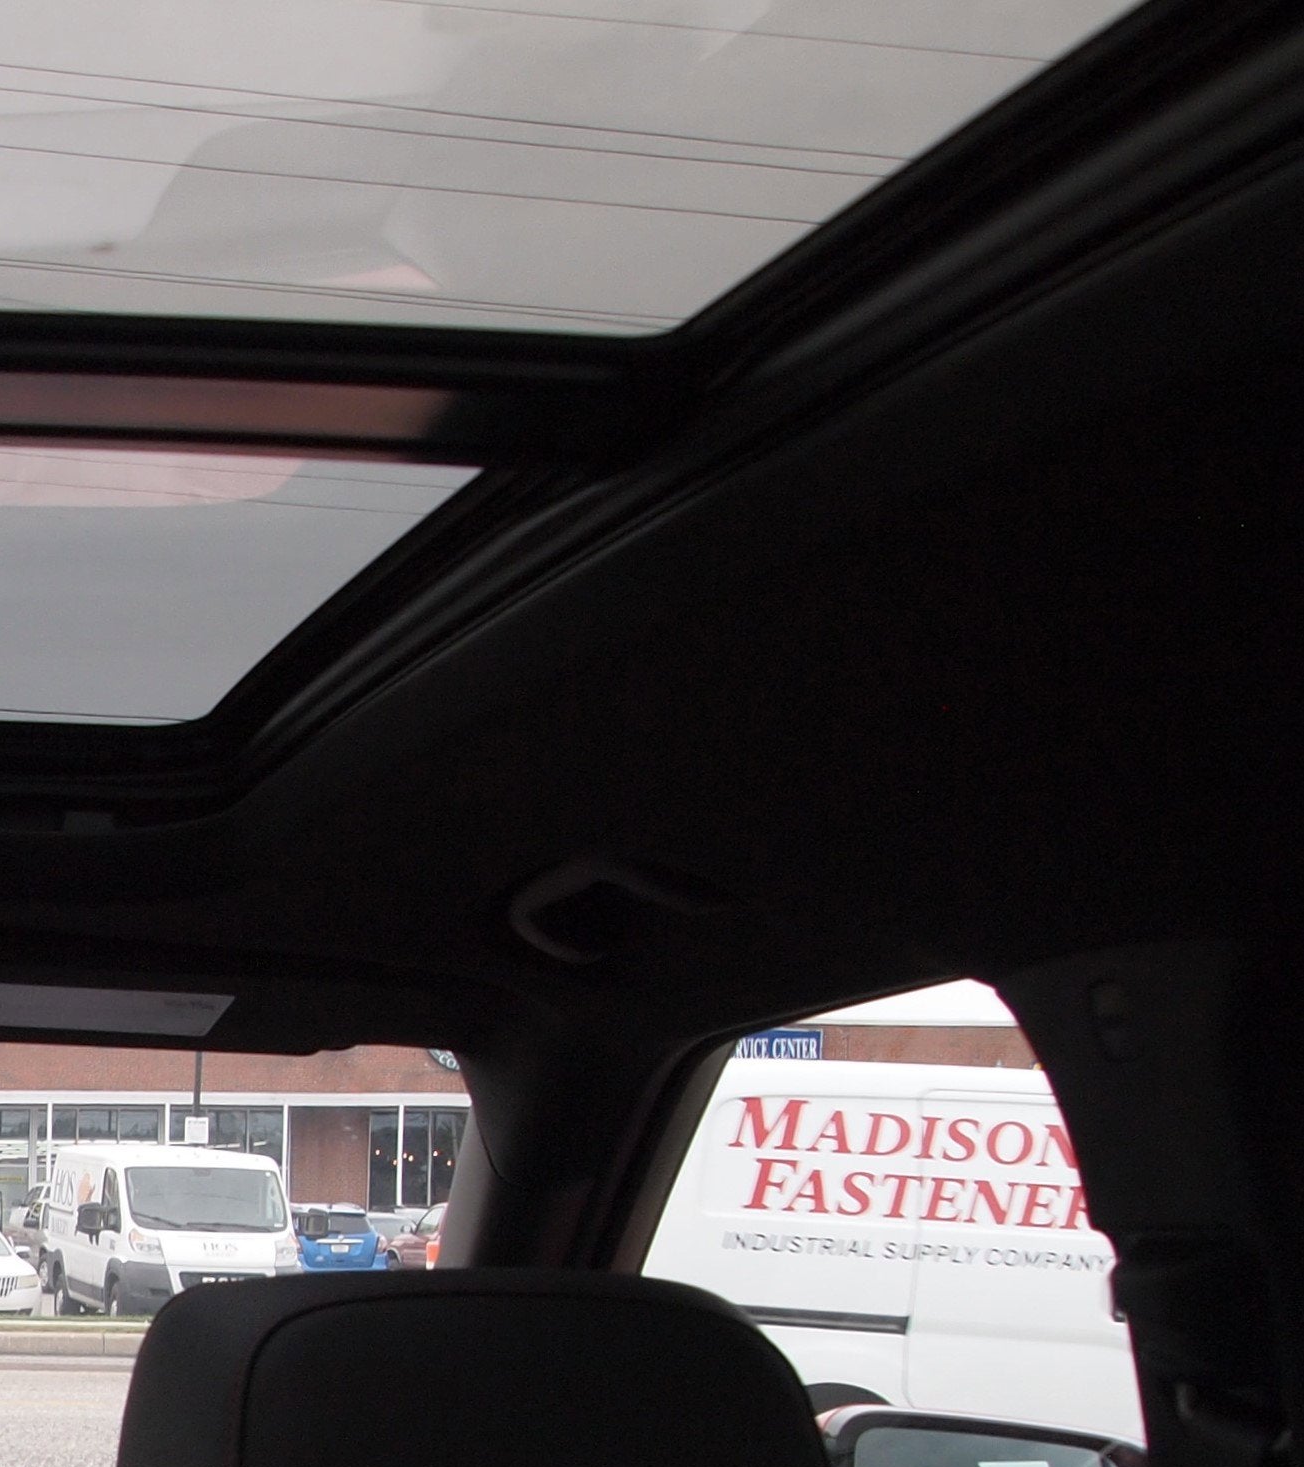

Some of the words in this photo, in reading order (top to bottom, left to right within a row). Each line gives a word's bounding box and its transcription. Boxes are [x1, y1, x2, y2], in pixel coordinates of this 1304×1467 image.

[772, 1037, 818, 1059] CENTER
[727, 1096, 1079, 1169] MADISON
[722, 1231, 875, 1259] INDUSTRIAL
[883, 1242, 982, 1265] SUPPLY
[985, 1248, 1113, 1273] COMPANY
